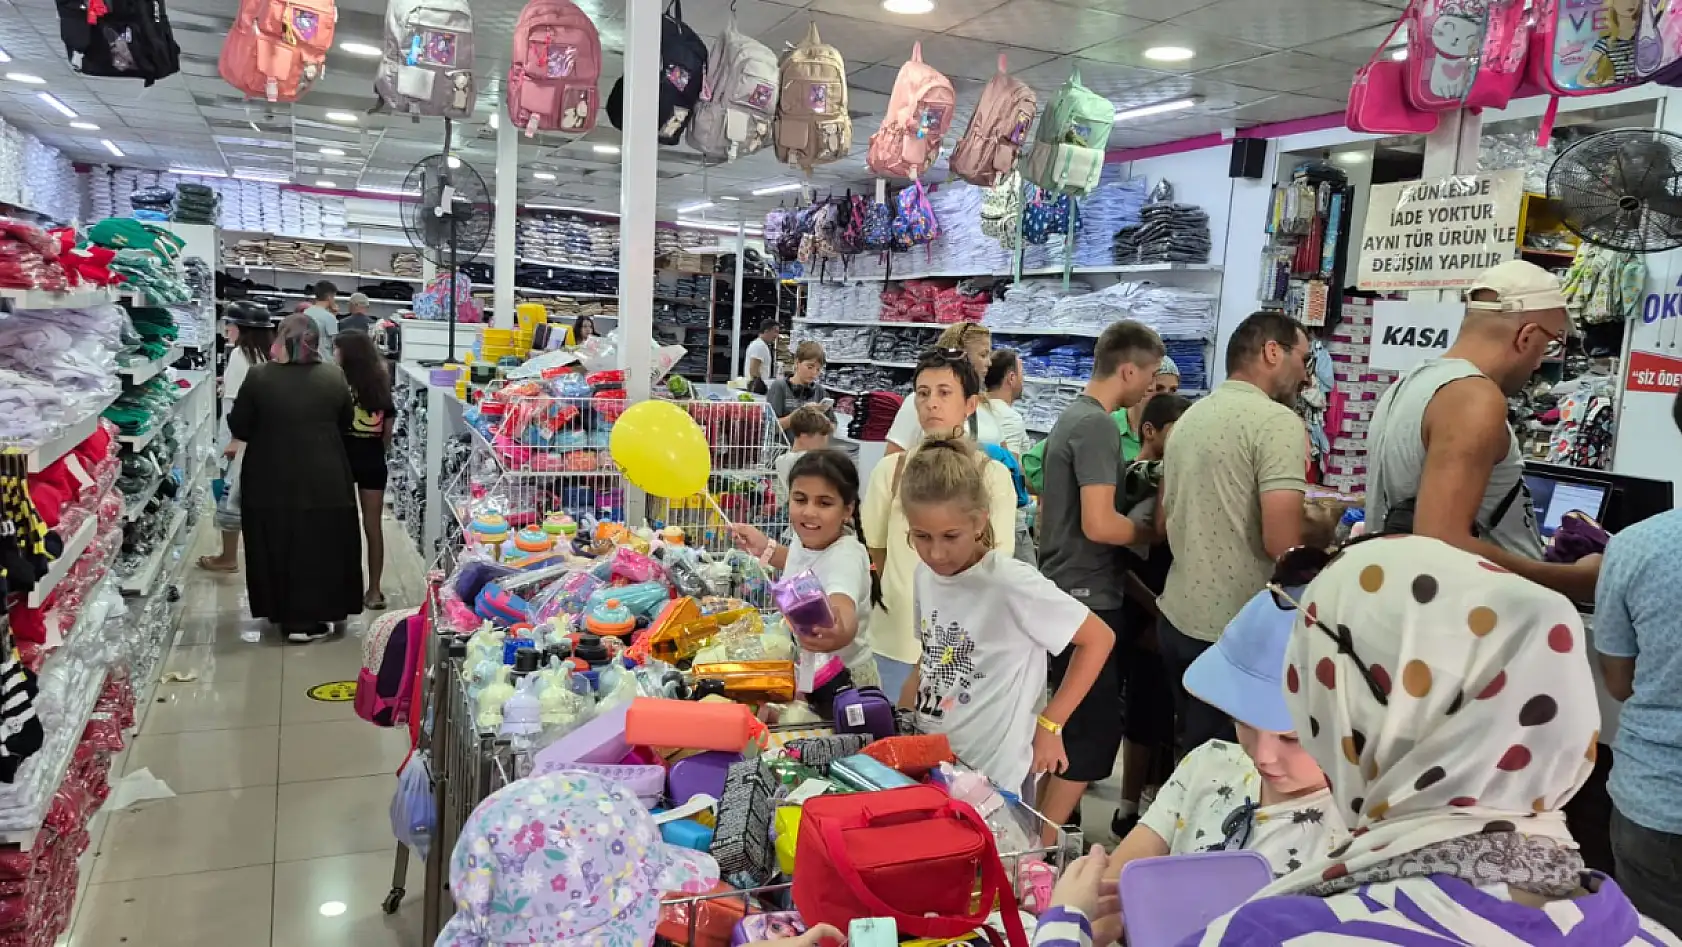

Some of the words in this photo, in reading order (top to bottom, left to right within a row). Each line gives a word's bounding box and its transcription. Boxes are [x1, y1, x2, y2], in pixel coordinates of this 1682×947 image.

[1390, 208, 1423, 227] İADE
[1428, 203, 1493, 224] YOKTUR
[1363, 235, 1399, 251] AYNI
[1404, 229, 1433, 248] TÜR
[1438, 225, 1487, 246] ÜRÜN
[1493, 223, 1516, 243] İLE
[1438, 252, 1501, 270] YAPILIR
[1381, 325, 1450, 349] KASA
[1657, 369, 1682, 387] ÖDE
